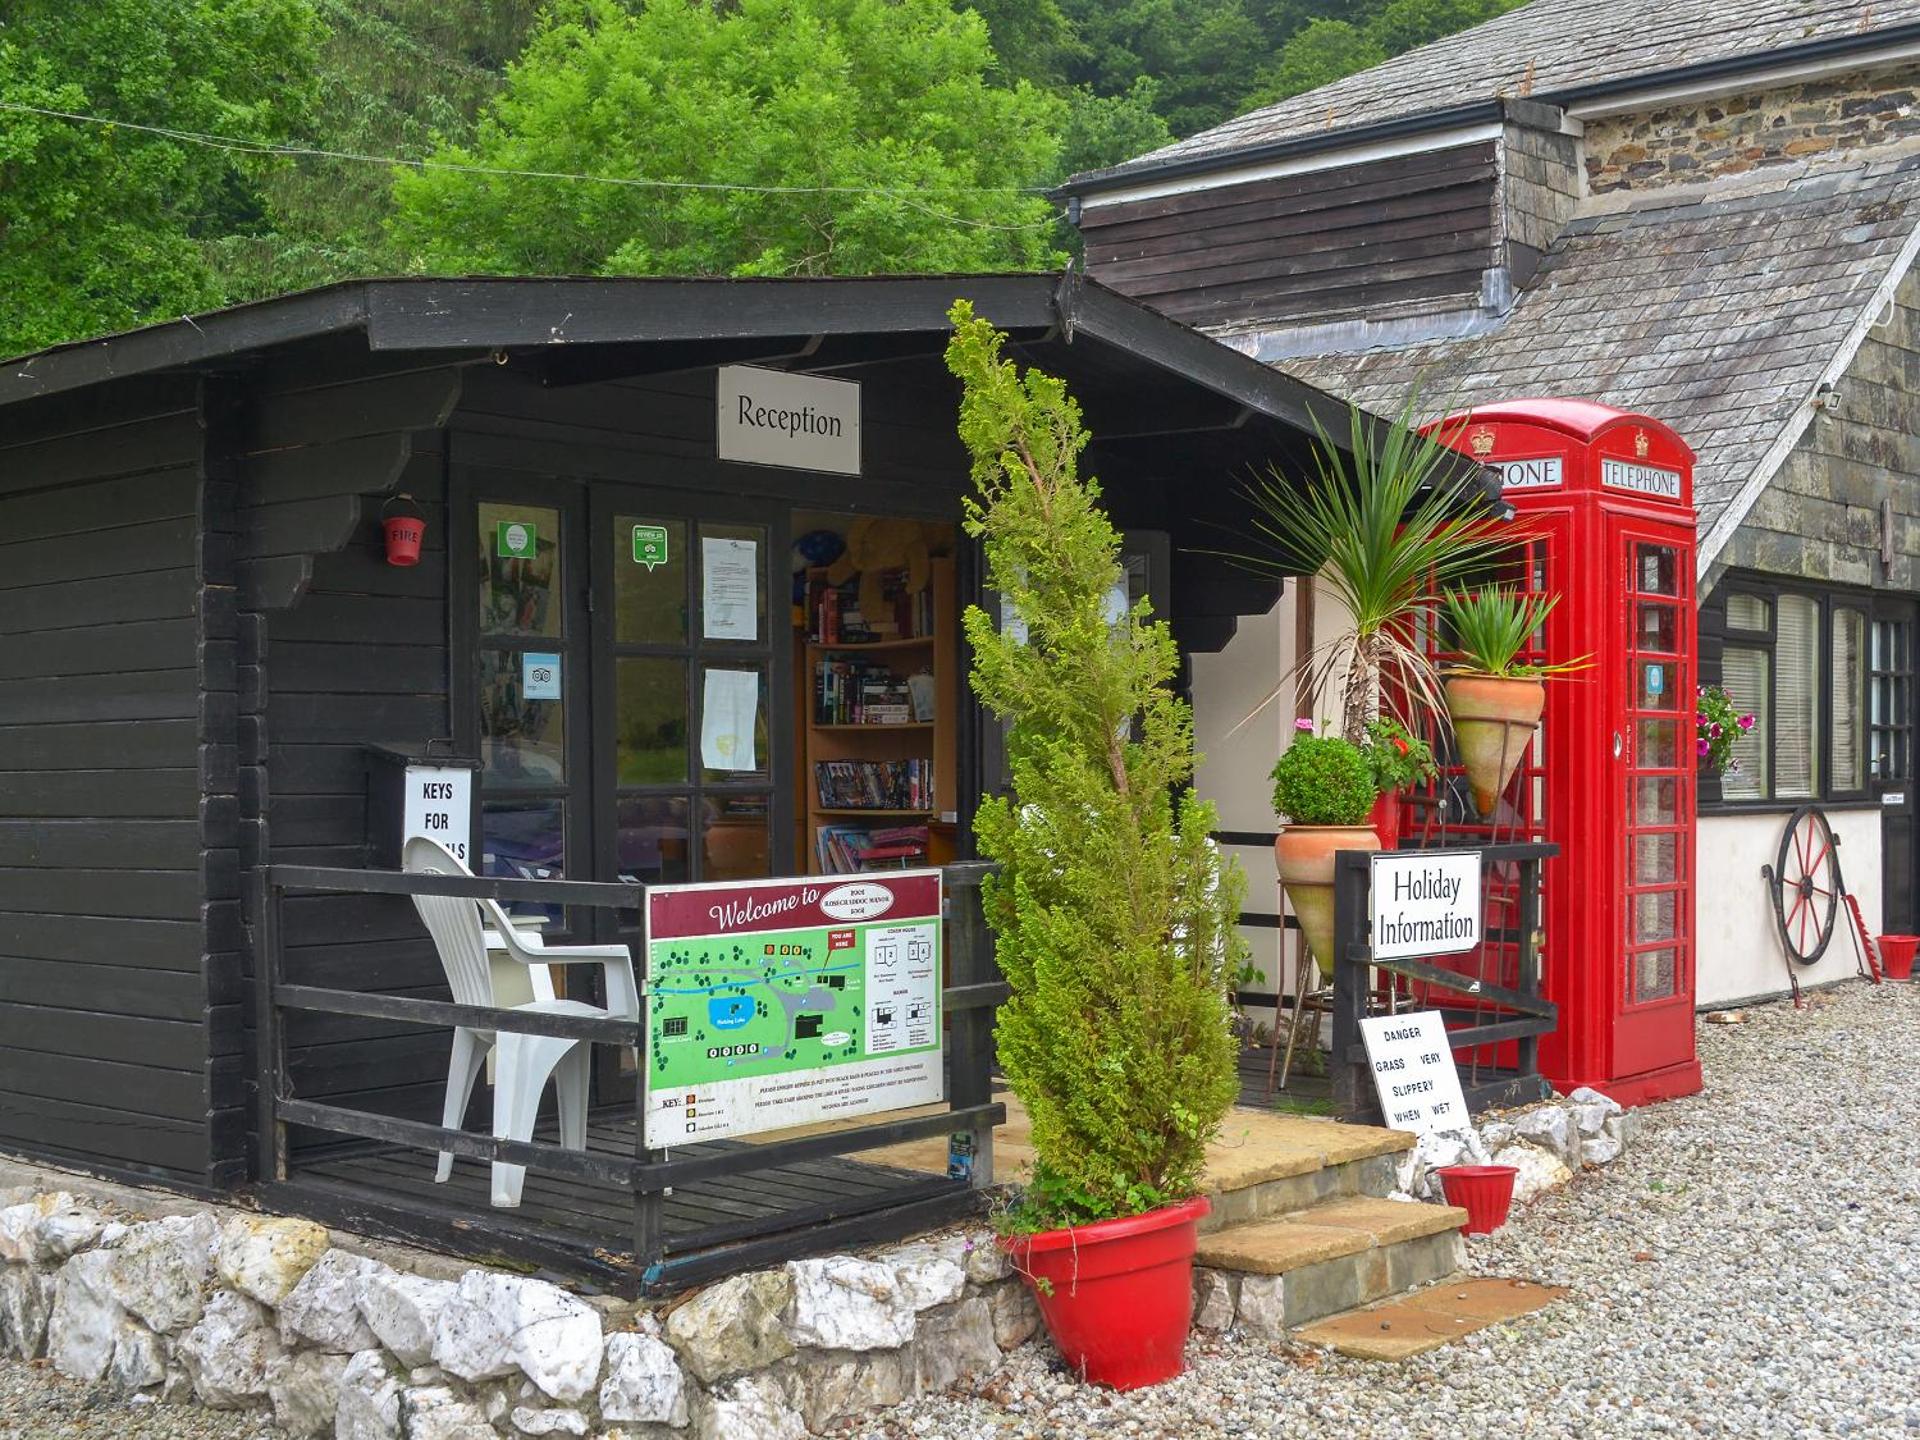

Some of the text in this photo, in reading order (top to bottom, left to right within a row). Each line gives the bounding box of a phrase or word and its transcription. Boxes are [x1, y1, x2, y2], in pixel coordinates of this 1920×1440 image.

[738, 394, 843, 439] Reception
[1603, 461, 1676, 495] TELEPHONE
[391, 529, 418, 543] FIRE
[423, 782, 453, 800] KEYS
[424, 813, 449, 830] FOR
[1394, 868, 1461, 906] Holiday
[709, 886, 820, 931] Welcome to
[1380, 911, 1473, 945] Information
[1384, 1027, 1422, 1042] DANGER
[1375, 1052, 1441, 1072] GRASS VERY
[1392, 1080, 1434, 1097] SLIPPERY
[1394, 1102, 1451, 1124] WHEN WET
